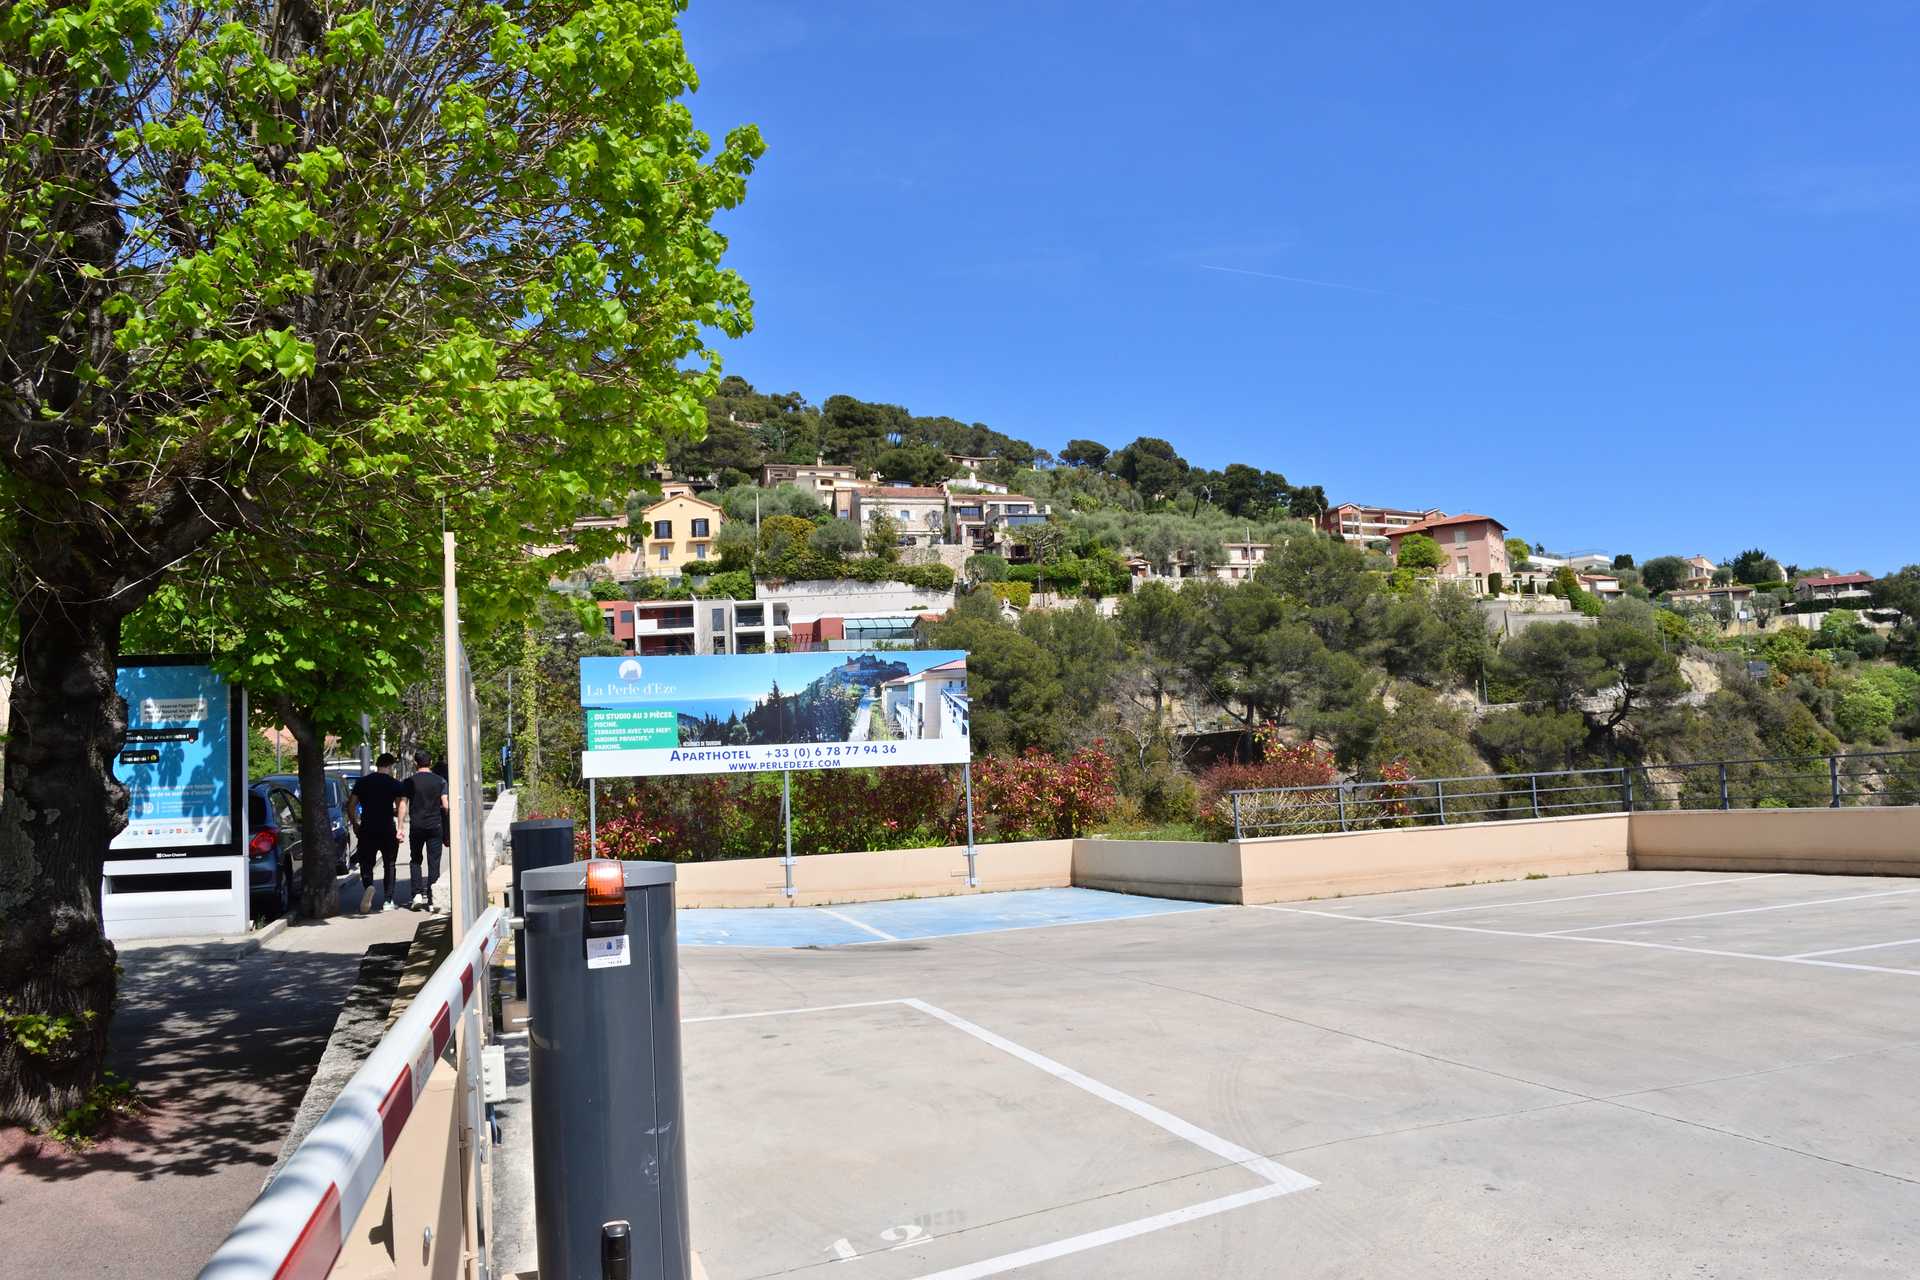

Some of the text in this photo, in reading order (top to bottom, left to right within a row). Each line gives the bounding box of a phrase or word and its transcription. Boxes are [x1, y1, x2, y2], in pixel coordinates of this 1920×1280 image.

[587, 682, 677, 697] La Perle d'Eze
[649, 711, 674, 719] PIÈCES.
[765, 748, 789, 759] +33
[794, 747, 811, 759] (0)
[815, 748, 822, 756] 6
[826, 747, 841, 756] 78
[845, 746, 859, 755] 77
[863, 745, 878, 755] 94
[882, 744, 897, 754] 36
[728, 759, 841, 771] WWW.PERLEDEZE.COM
